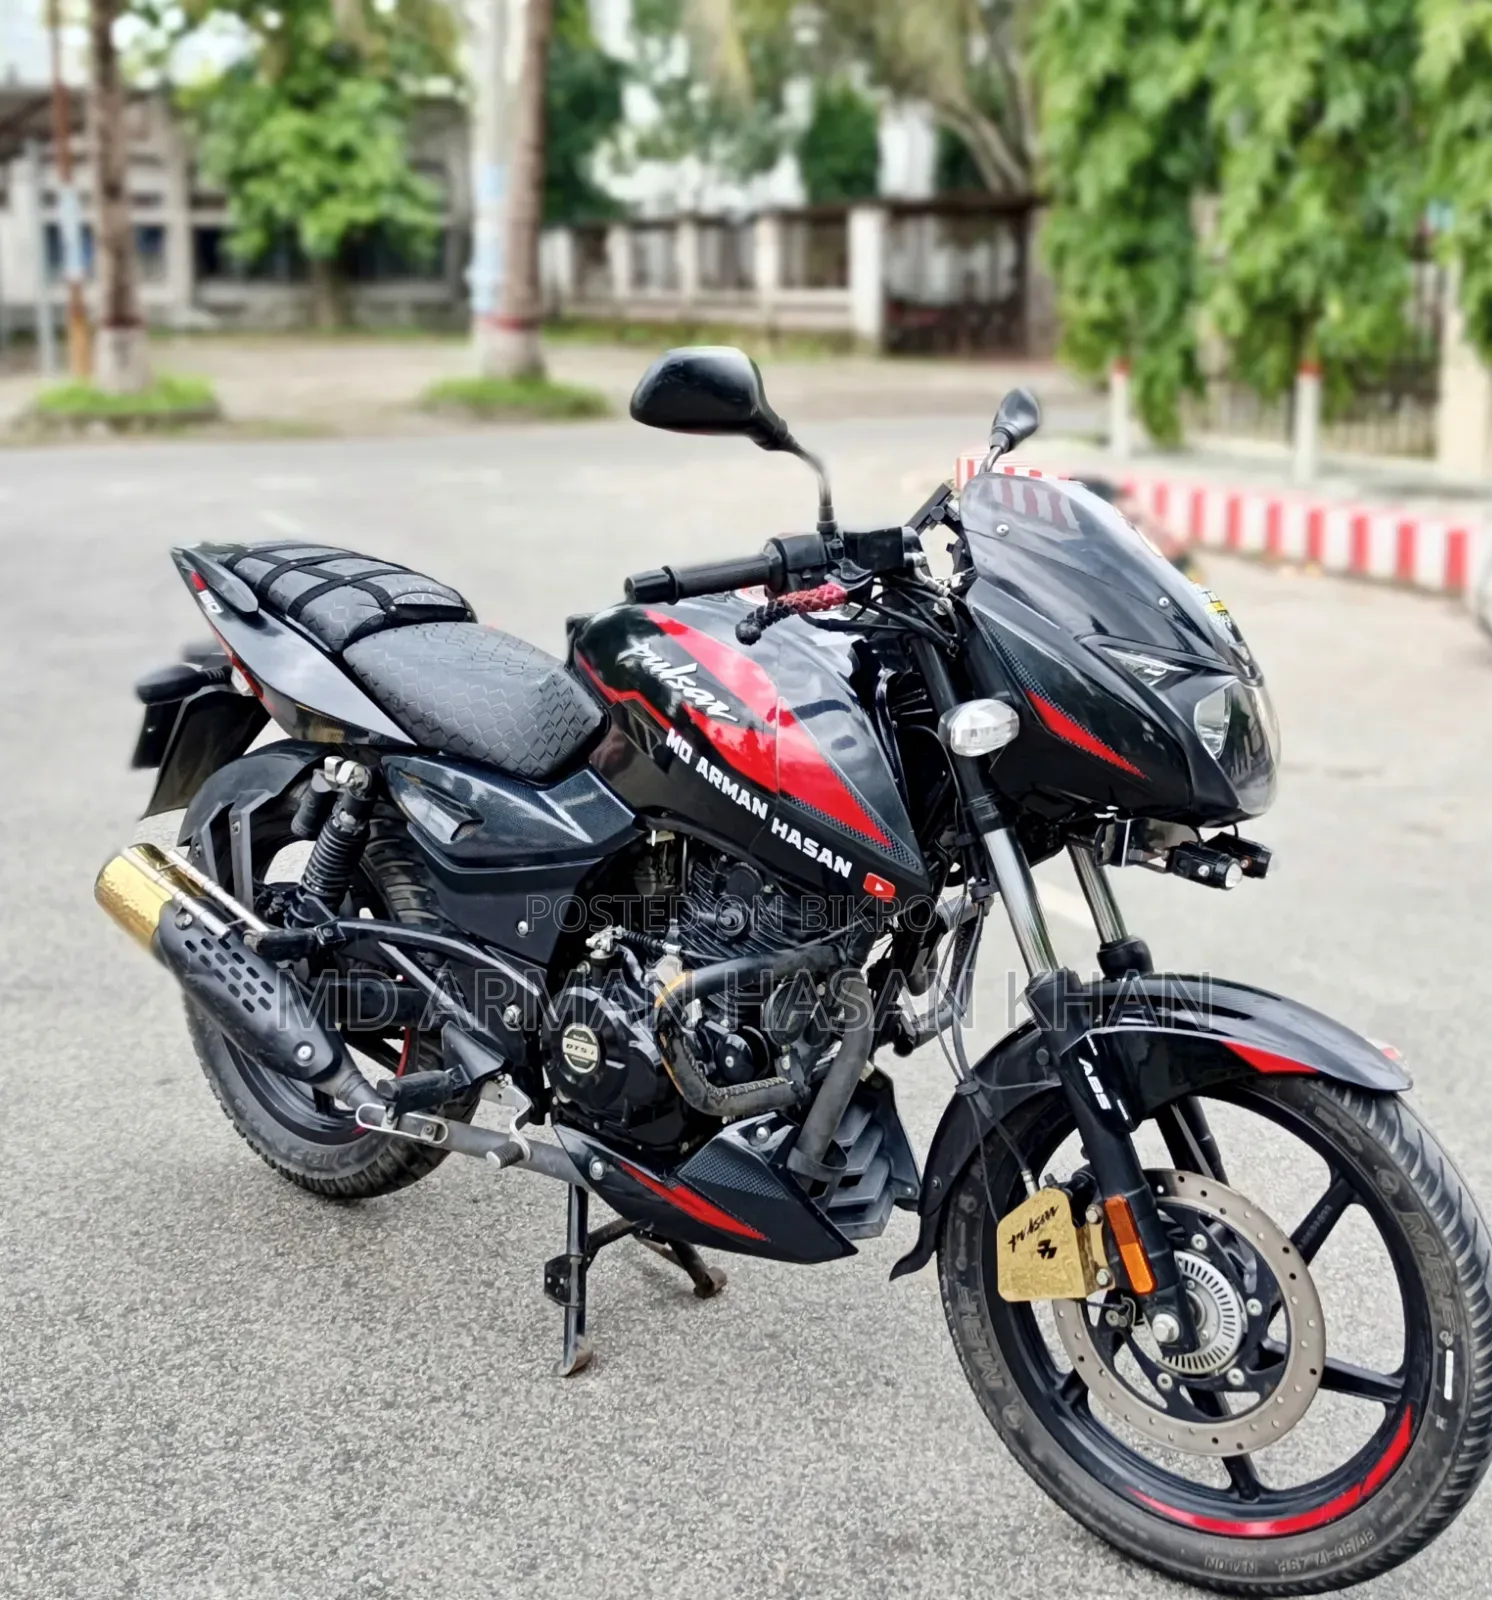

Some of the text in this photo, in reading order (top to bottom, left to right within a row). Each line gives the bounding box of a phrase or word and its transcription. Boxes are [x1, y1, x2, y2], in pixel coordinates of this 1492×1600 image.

[665, 728, 853, 879] MD ARMAN HASAN
[1078, 1056, 1112, 1110] ABS
